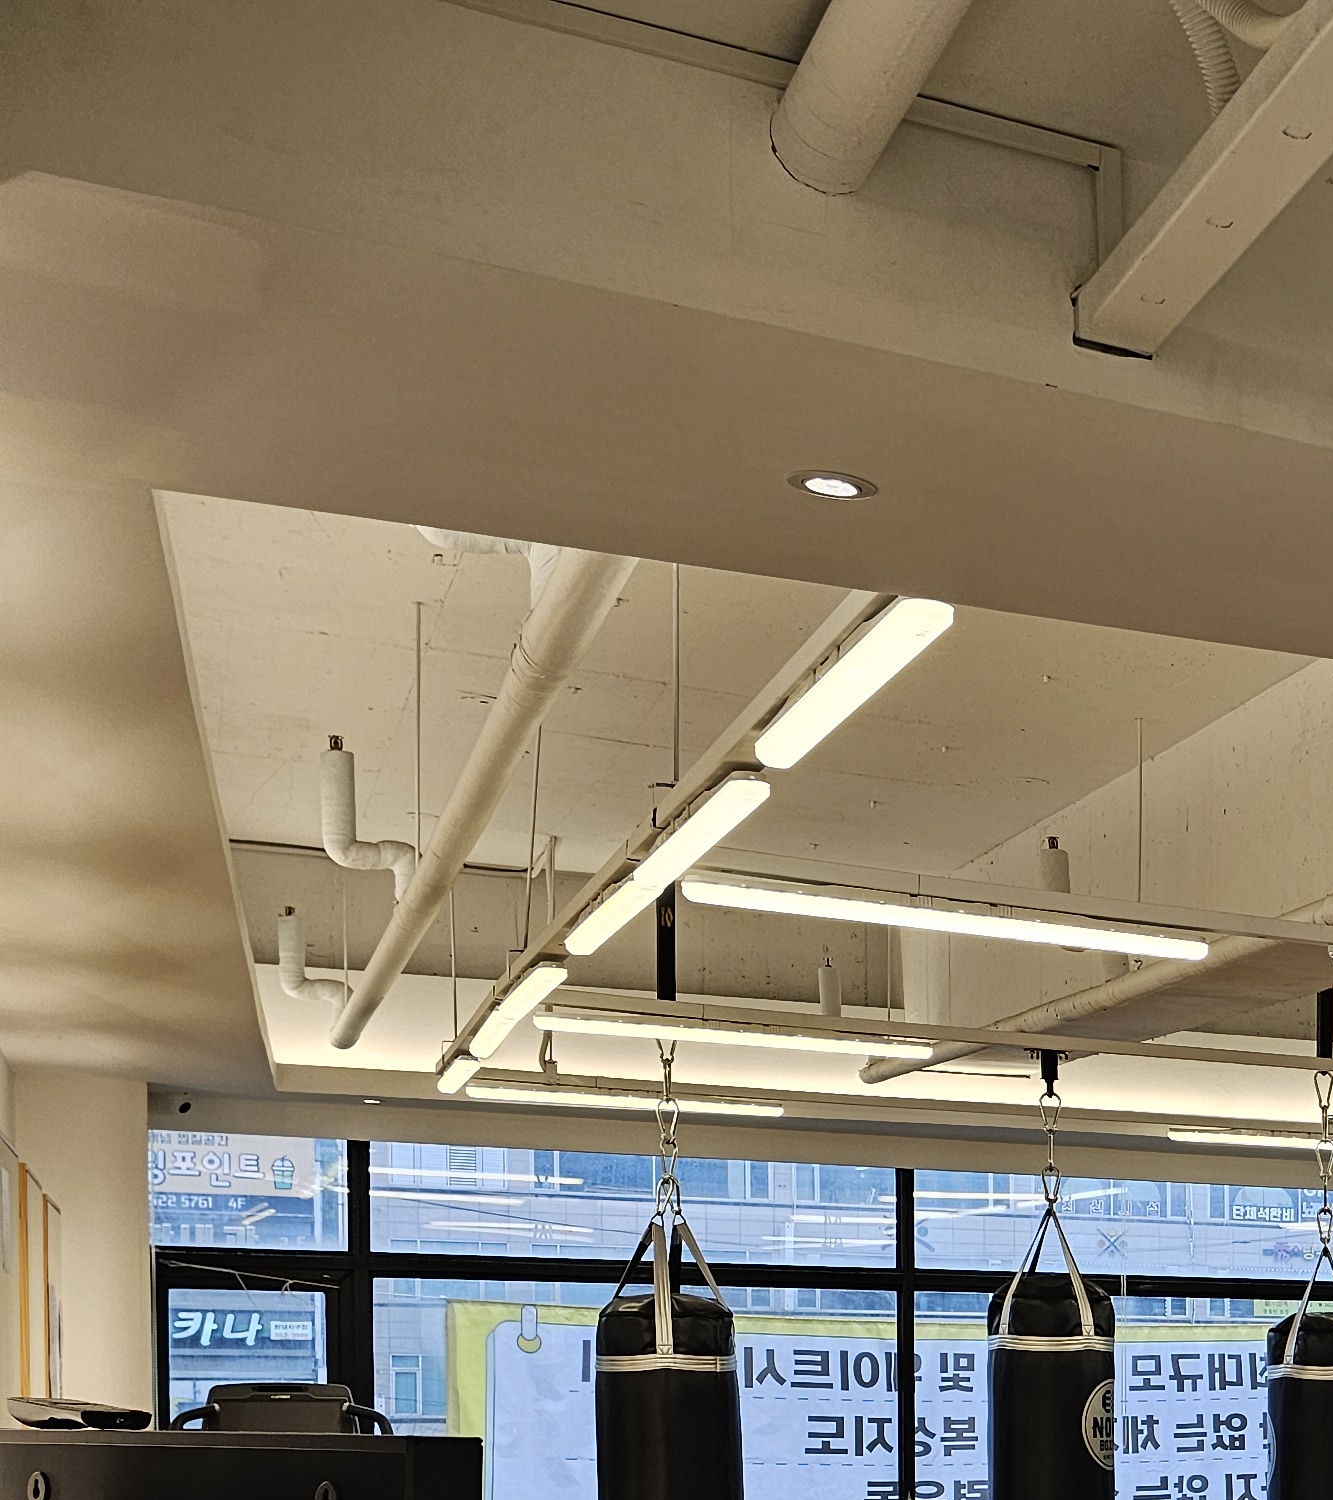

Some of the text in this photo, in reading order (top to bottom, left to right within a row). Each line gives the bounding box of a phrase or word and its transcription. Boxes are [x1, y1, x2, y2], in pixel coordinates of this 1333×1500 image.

[181, 1195, 213, 1209] 5761
[228, 1197, 247, 1210] 4F
[172, 1311, 263, 1347] 카나
